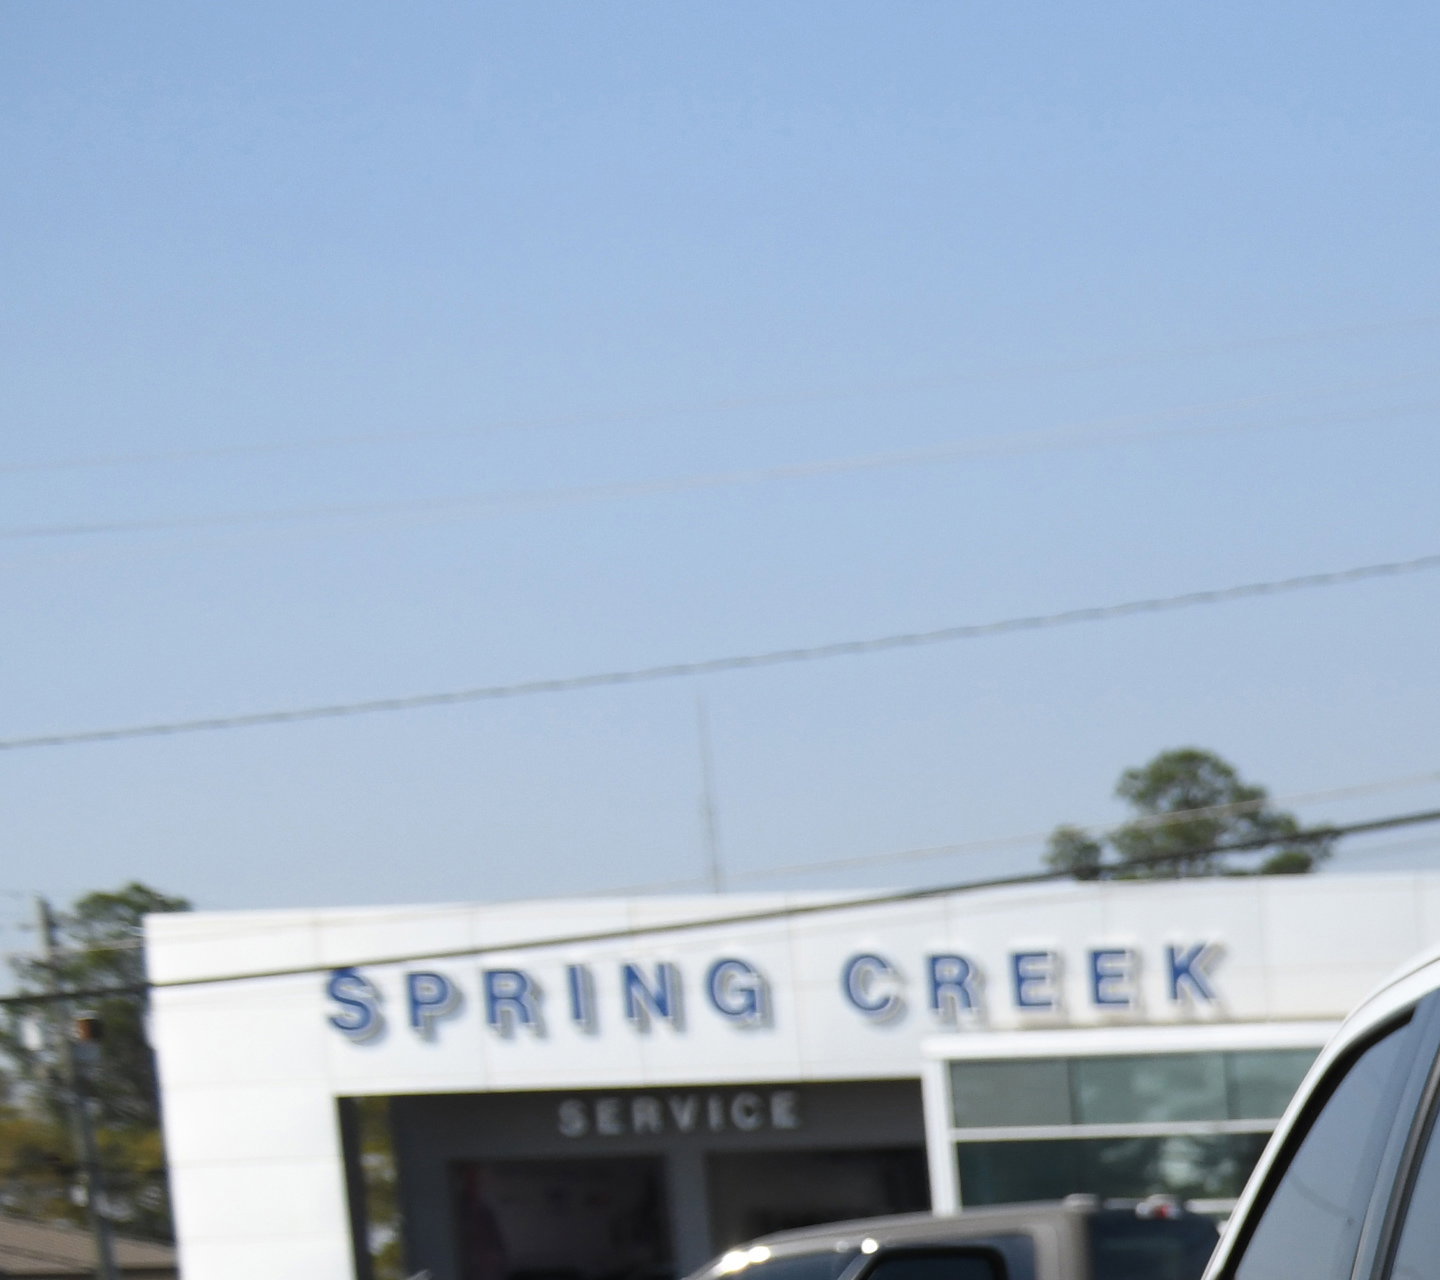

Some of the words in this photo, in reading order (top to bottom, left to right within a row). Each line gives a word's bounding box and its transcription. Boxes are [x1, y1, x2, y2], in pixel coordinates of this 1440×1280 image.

[327, 960, 768, 1038] SPRING
[843, 941, 1222, 1018] CREEK
[556, 1090, 799, 1139] SERVICE
